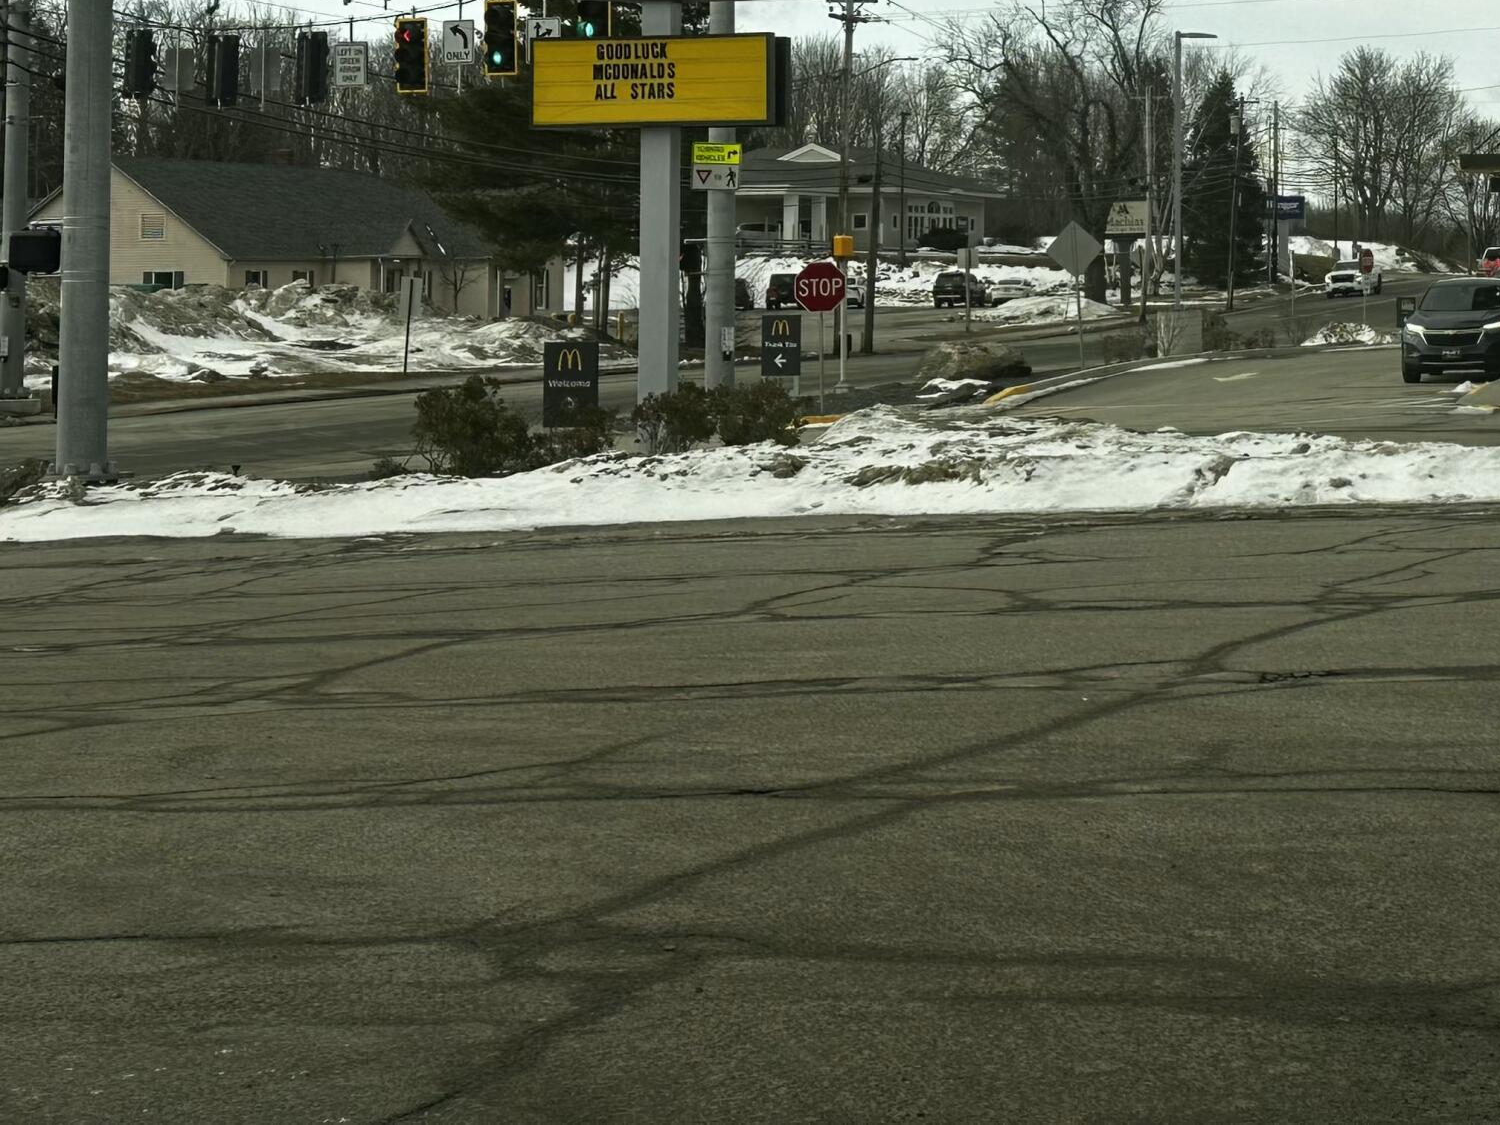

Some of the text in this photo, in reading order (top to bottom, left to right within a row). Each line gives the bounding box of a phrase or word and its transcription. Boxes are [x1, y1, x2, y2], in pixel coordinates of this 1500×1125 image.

[446, 51, 471, 61] ONLY
[596, 42, 668, 60] GOOD LUCK
[593, 62, 676, 80] MCDONALDS
[595, 82, 676, 100] ALL STARS
[799, 278, 843, 297] STOP
[548, 379, 591, 388] Welcome
